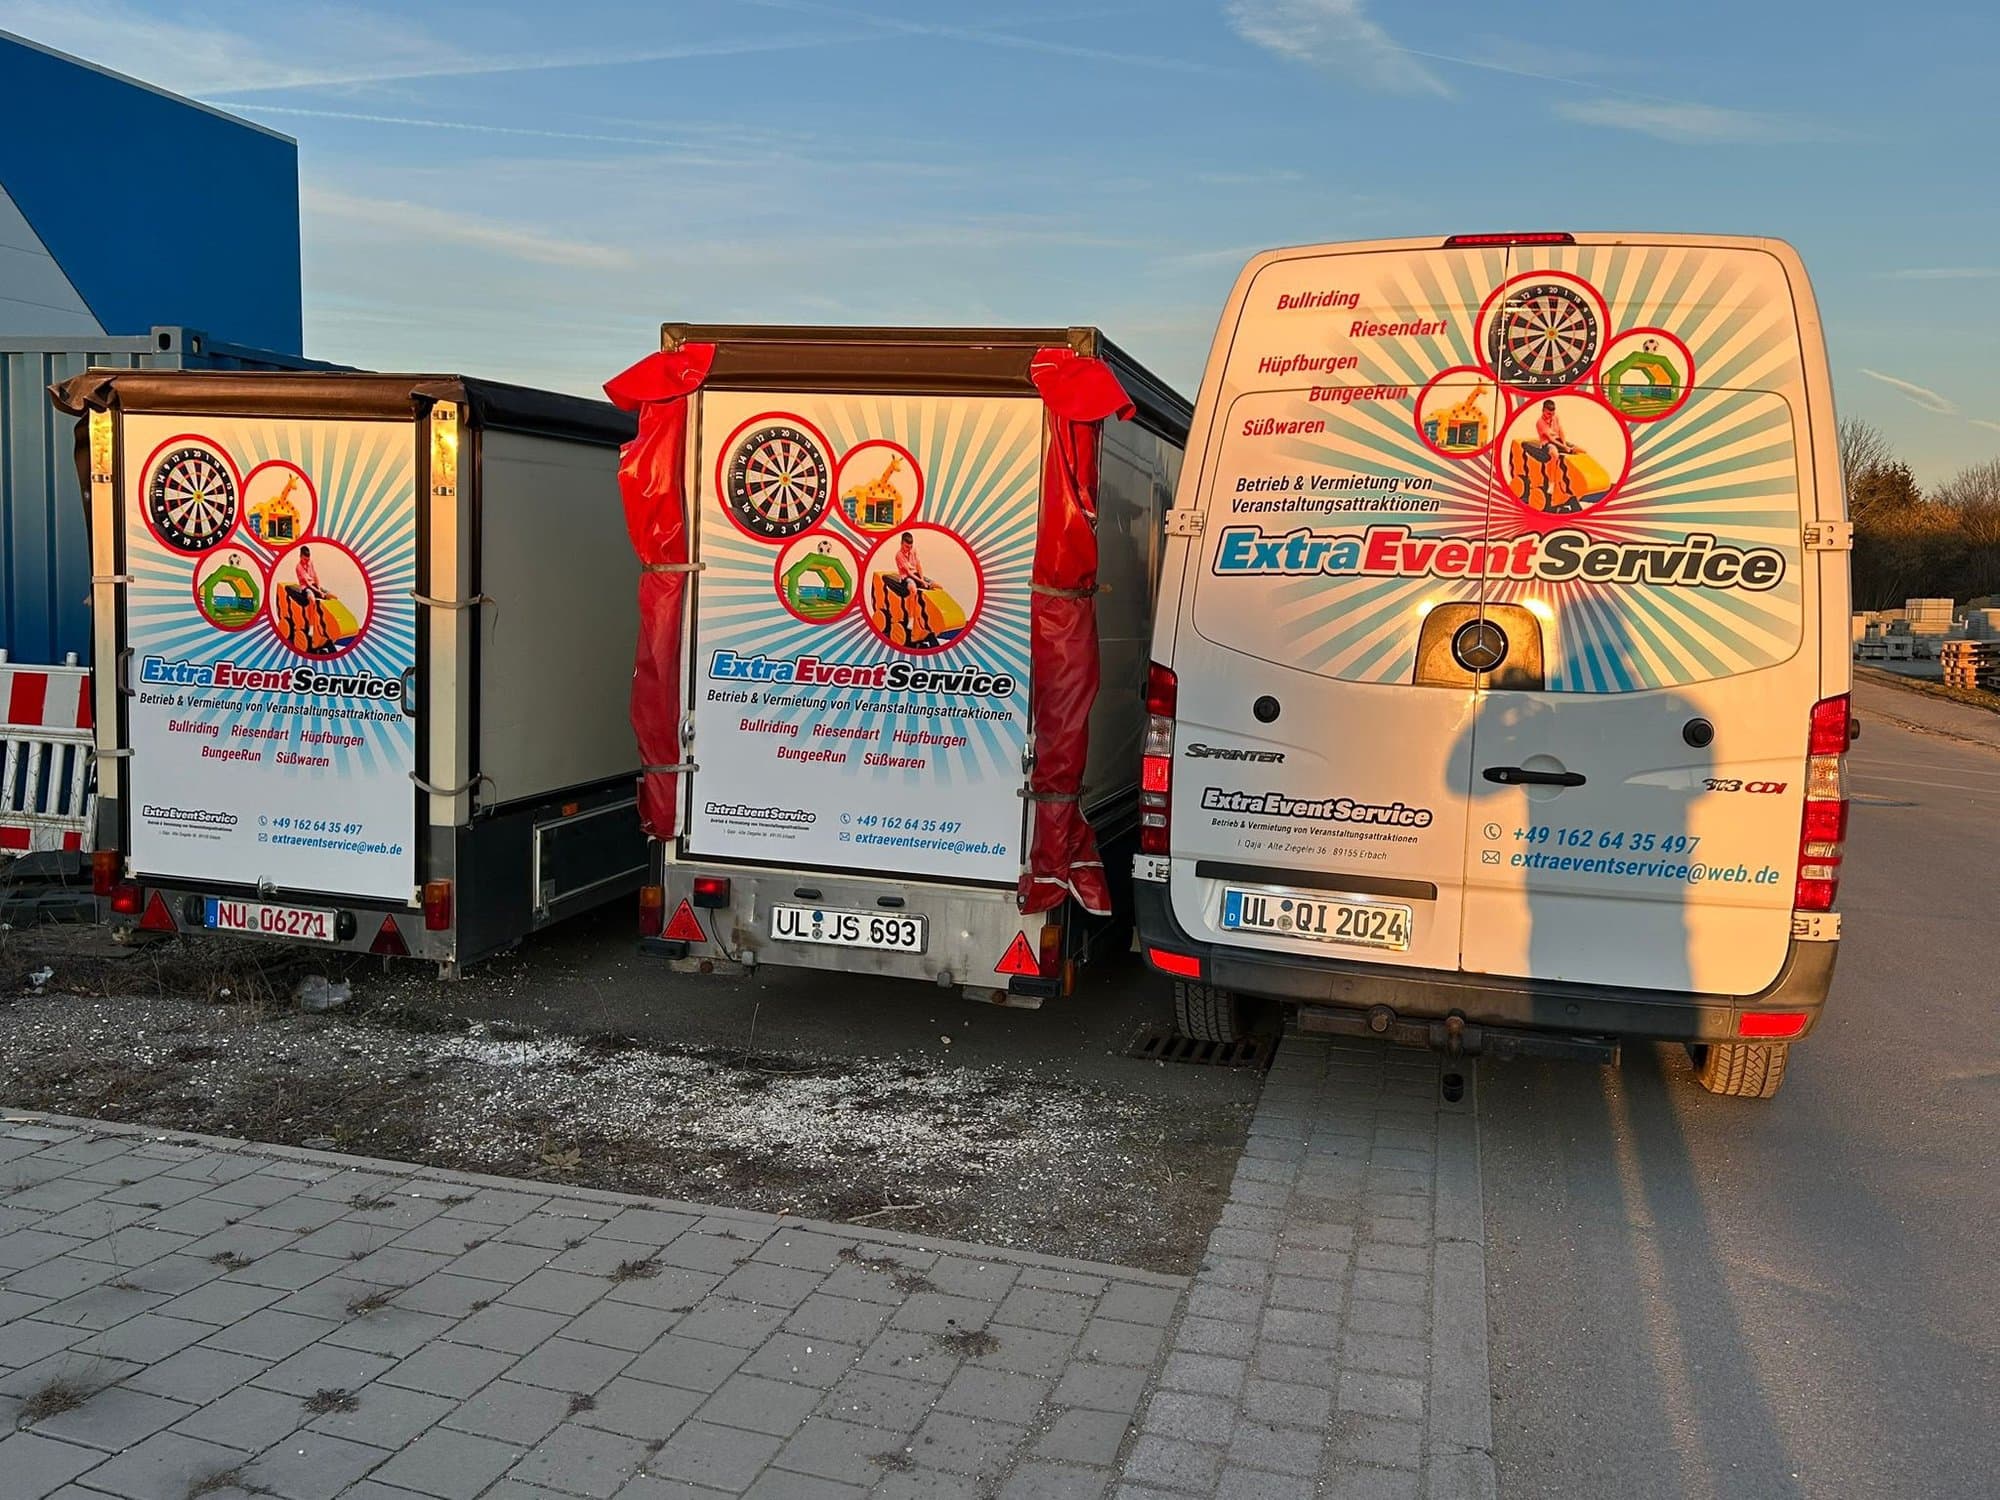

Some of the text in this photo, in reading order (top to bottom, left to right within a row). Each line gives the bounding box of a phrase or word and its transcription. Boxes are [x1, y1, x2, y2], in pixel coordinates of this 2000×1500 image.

[1277, 290, 1360, 310] Bullriding
[1349, 318, 1448, 338] Riesendart
[1258, 353, 1358, 376] Hüpfburgen
[1309, 384, 1408, 405] BungeeRun
[1242, 417, 1325, 437] Süßwaren
[1235, 475, 1433, 493] Betrieb & Vermietung von
[742, 502, 751, 513] 16
[1232, 496, 1440, 515] Veranstaltungsattraktionen
[765, 523, 774, 532] 19
[1216, 527, 1781, 588] ExtraEventService
[141, 657, 402, 699] ExtraEventService
[710, 651, 1015, 697] ExtraEventService
[140, 693, 402, 722] Betrieb & Vermietung von Veranstaltungsattraktionen
[707, 690, 1013, 722] Betrieb & Vermietung von Veranstaltungsattraktionen
[168, 720, 365, 748] Bullriding Riesendart Hüpfburgen
[740, 719, 967, 748] Bullriding Riesendart Hüpfburgen
[201, 746, 329, 767] BungeeRun Süßwaren
[777, 746, 926, 769] BungeeRun Süßwaren
[1744, 781, 1788, 794] CDI
[705, 802, 816, 823] ExtraEventService
[1201, 786, 1434, 828] ExtraEventService
[272, 818, 363, 835] +49 162 64 35 497
[856, 815, 961, 834] +49 162 64 35 497
[1211, 818, 1418, 844] Betrieb & Vermietung von Veranstaltungsattraktionen
[272, 833, 402, 856] extraeventservice@web.de
[855, 832, 1006, 856] extraeventservice@web.de
[1513, 826, 1700, 855] +49 162 64 35 497
[1359, 850, 1388, 860] Erbach
[1511, 851, 1780, 885] extraeventservice@web.de
[218, 903, 327, 937] NU 06271
[777, 910, 916, 946] UL JS 693
[1229, 913, 1236, 921] D
[1242, 896, 1403, 941] UL QI 2024
